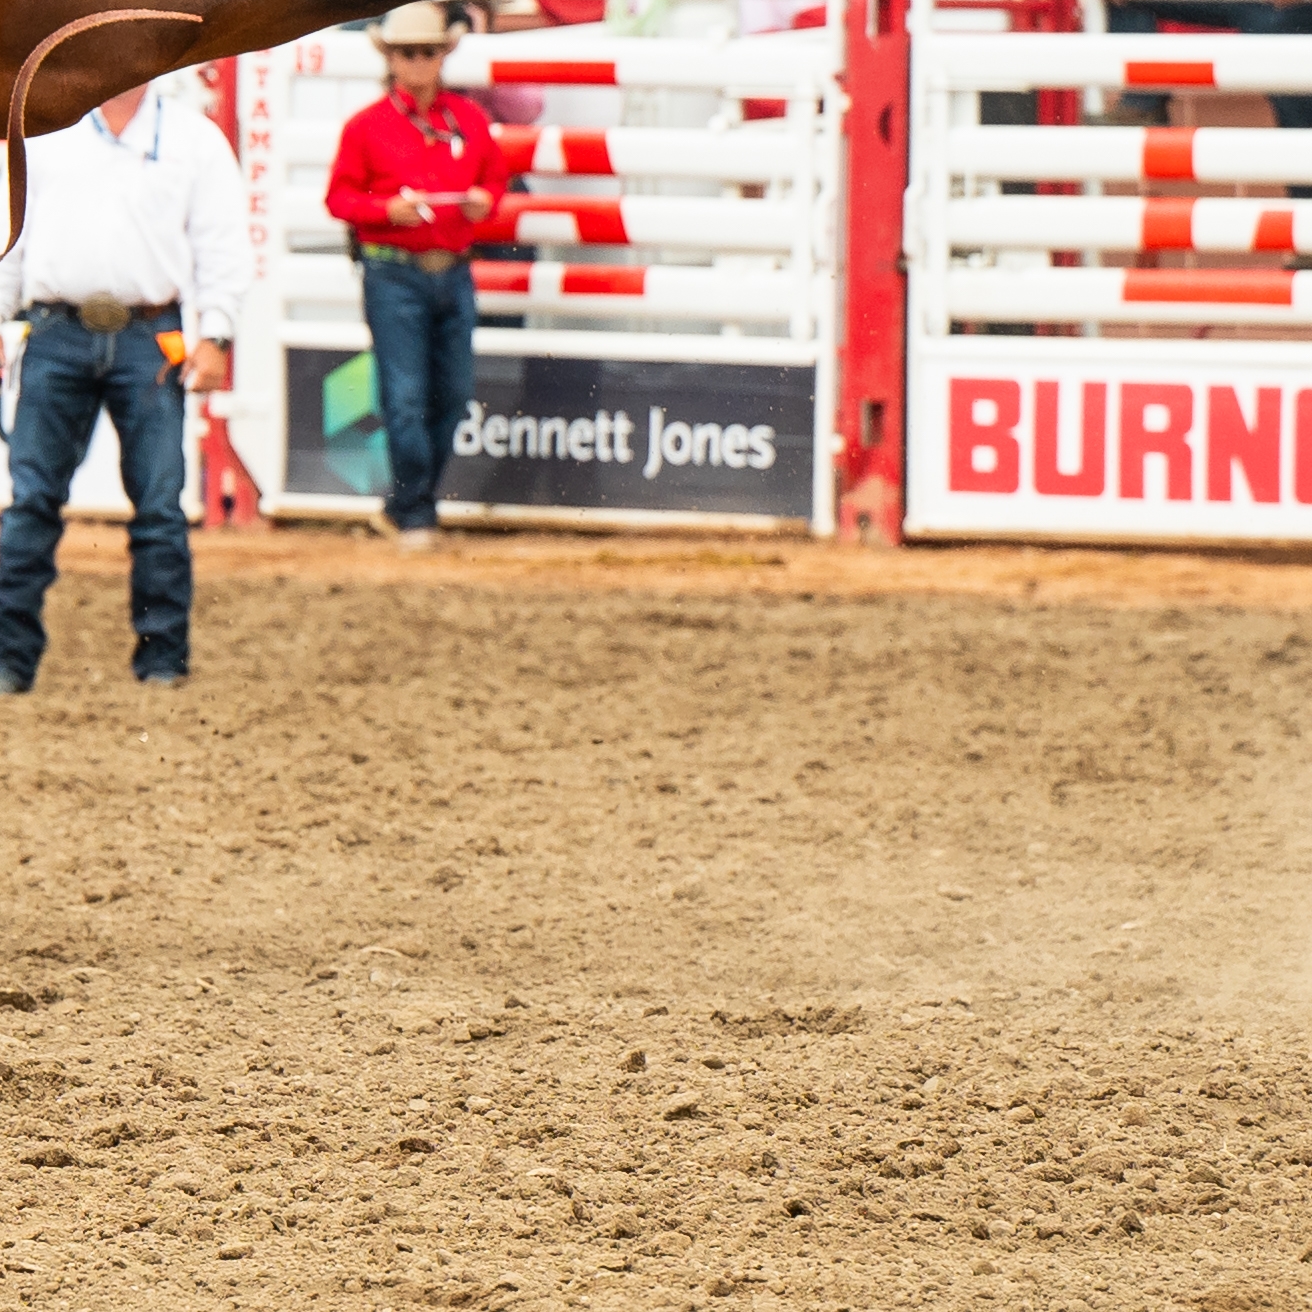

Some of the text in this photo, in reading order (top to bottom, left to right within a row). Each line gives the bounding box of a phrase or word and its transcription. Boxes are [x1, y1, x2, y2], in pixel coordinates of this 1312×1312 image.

[294, 43, 325, 75] 19
[641, 394, 778, 480] Jones
[950, 378, 1312, 505] BURN
